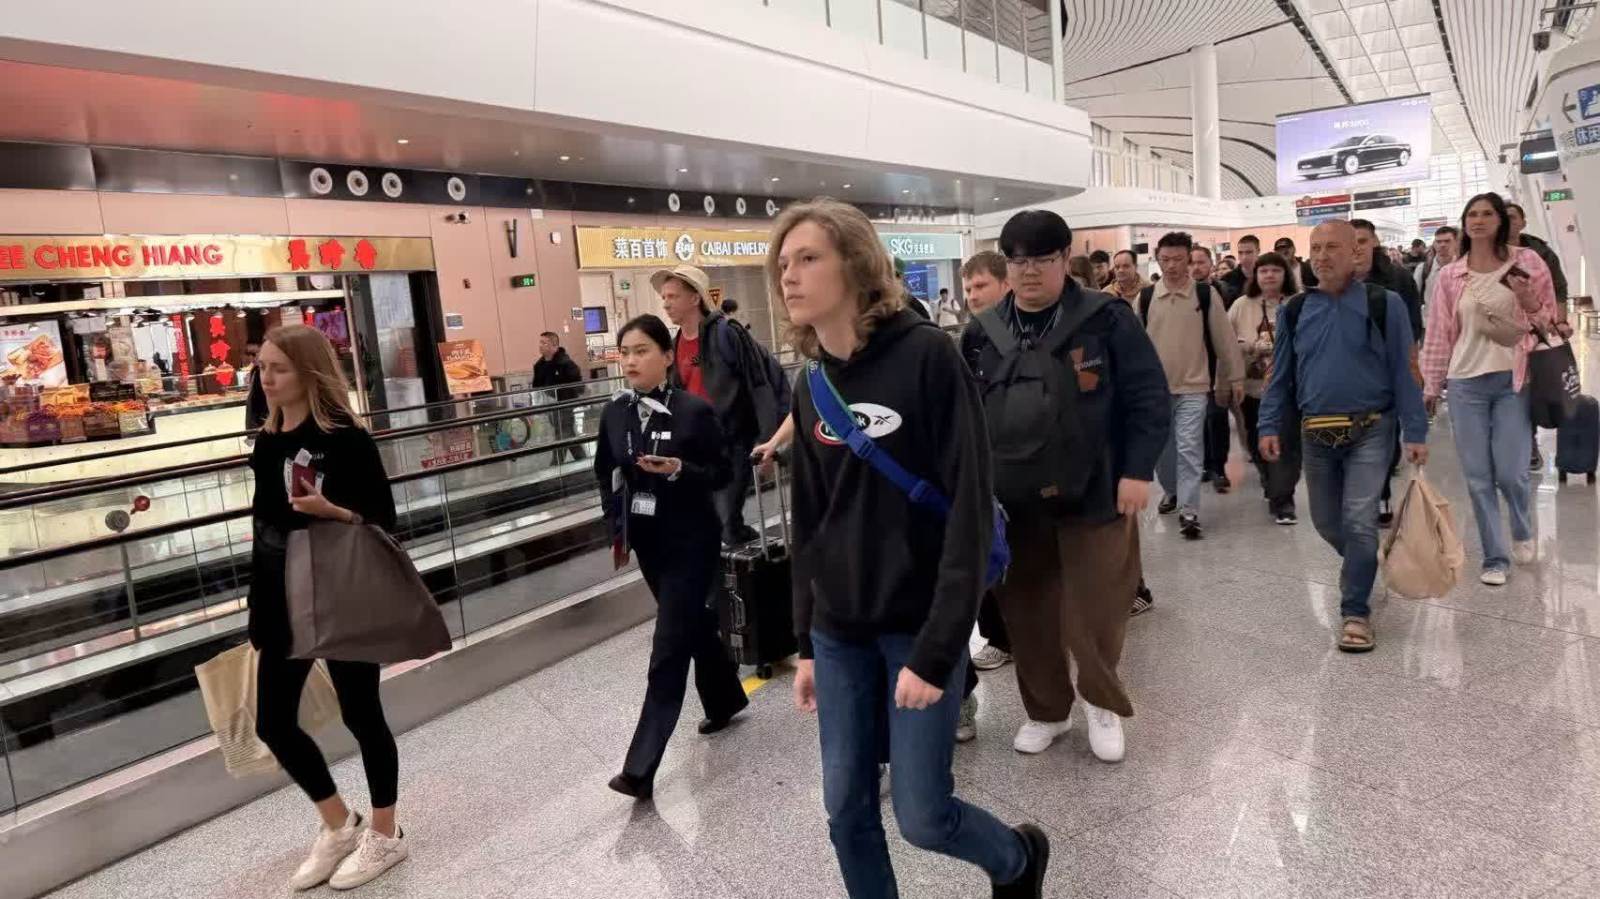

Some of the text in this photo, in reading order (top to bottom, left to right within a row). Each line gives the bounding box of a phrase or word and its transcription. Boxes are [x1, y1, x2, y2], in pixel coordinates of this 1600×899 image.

[613, 237, 668, 259] 菜百首饰
[700, 240, 731, 256] CAIBAI
[890, 238, 912, 255] SKG
[34, 244, 135, 270] CHENG
[142, 244, 224, 267] HIANG
